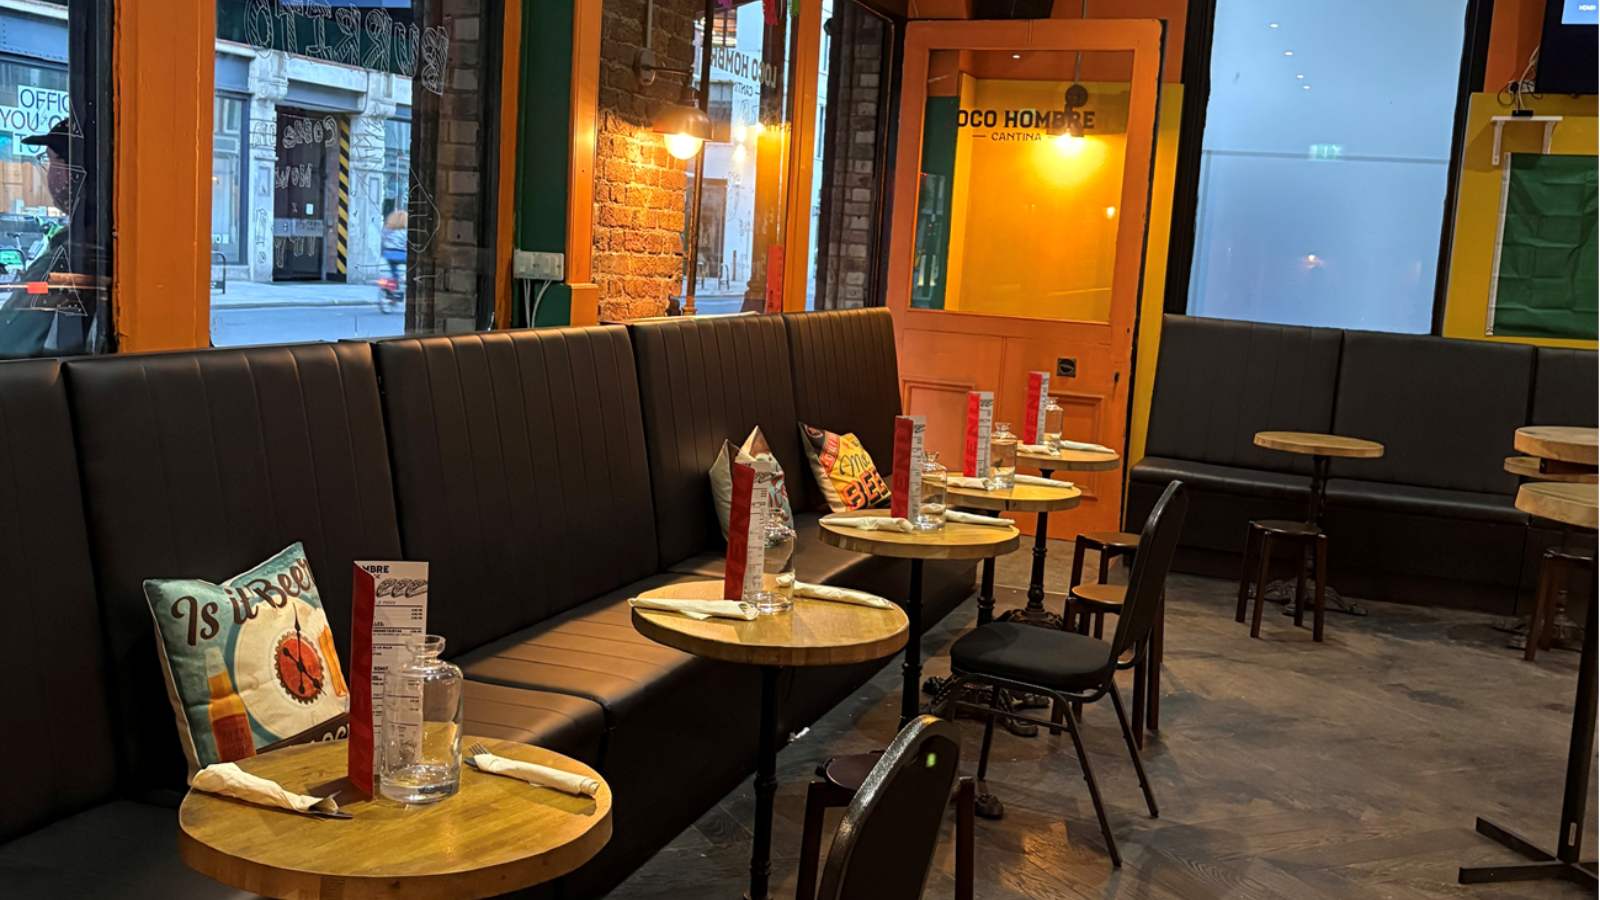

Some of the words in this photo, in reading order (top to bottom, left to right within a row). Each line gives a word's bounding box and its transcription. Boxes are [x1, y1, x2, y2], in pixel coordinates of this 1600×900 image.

[20, 88, 70, 113] OFFIC
[957, 109, 998, 128] OCO
[1004, 108, 1096, 129] HOMBRE
[991, 132, 1042, 142] CANTINA
[170, 595, 221, 646] Is
